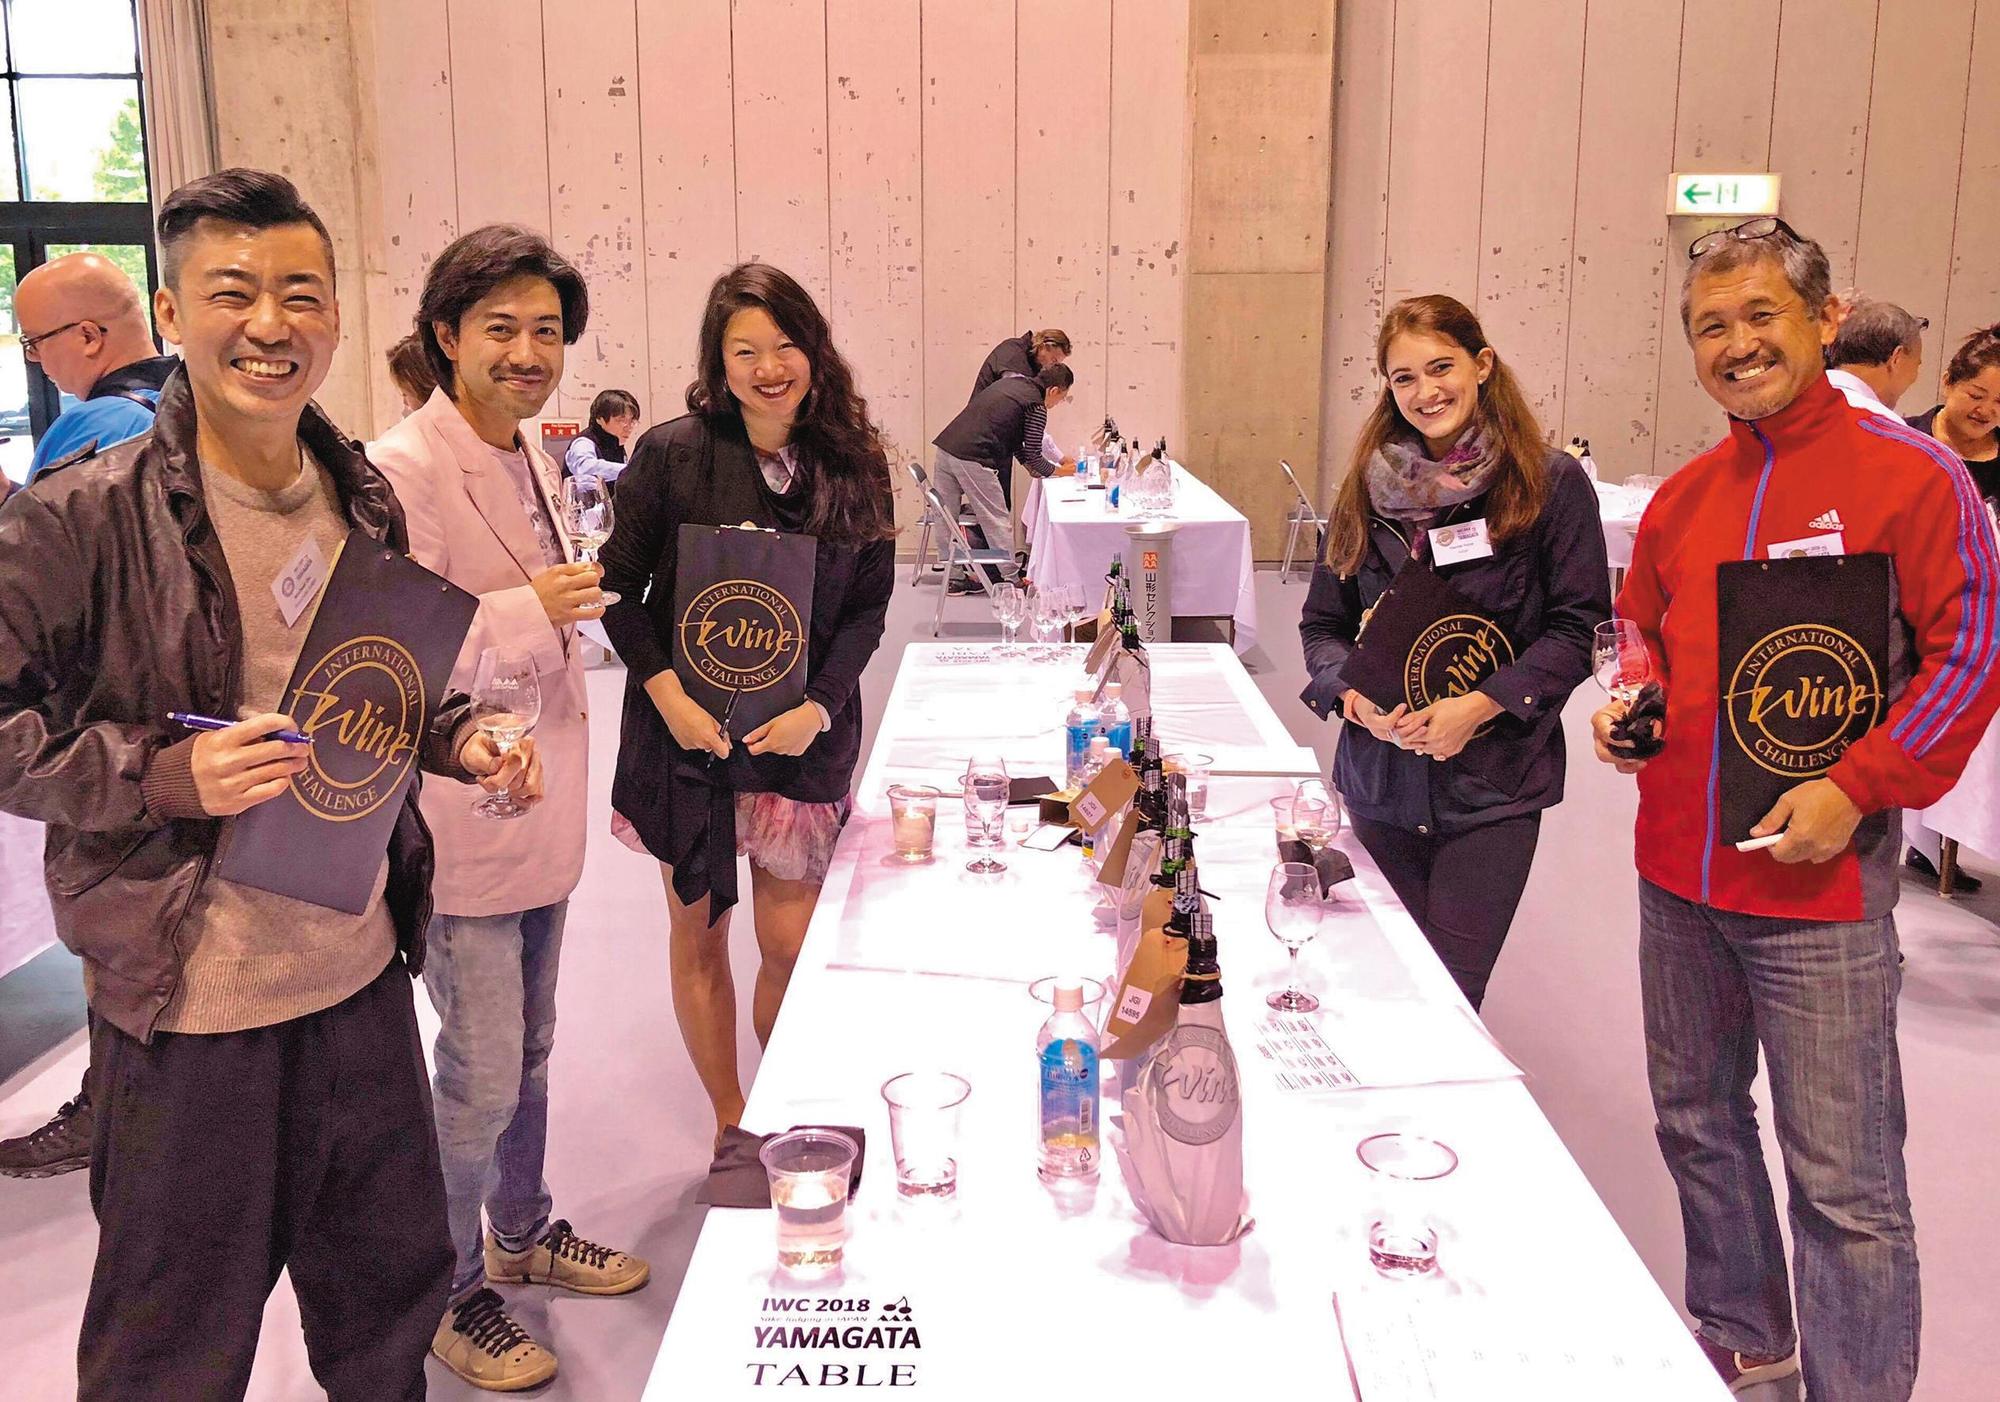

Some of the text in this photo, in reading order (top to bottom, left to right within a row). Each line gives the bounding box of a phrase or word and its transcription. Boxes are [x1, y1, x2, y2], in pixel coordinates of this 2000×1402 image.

[1808, 521, 1845, 531] adidas
[696, 584, 789, 618] INTERNATIONAL
[677, 617, 807, 652] Wine
[700, 657, 779, 686] CHALLENGE
[1409, 620, 1464, 706] INTERNATIONAL
[1745, 631, 1860, 677] INTERNATIONAL
[323, 644, 418, 712] INTERNATIONAL
[1722, 675, 1885, 723] Wine
[292, 688, 419, 766] Wine
[298, 767, 379, 811] HALLENGE
[762, 1298, 870, 1312] IWC 2018
[753, 1326, 922, 1349] YAMAGATA
[746, 1363, 917, 1387] TABLE
